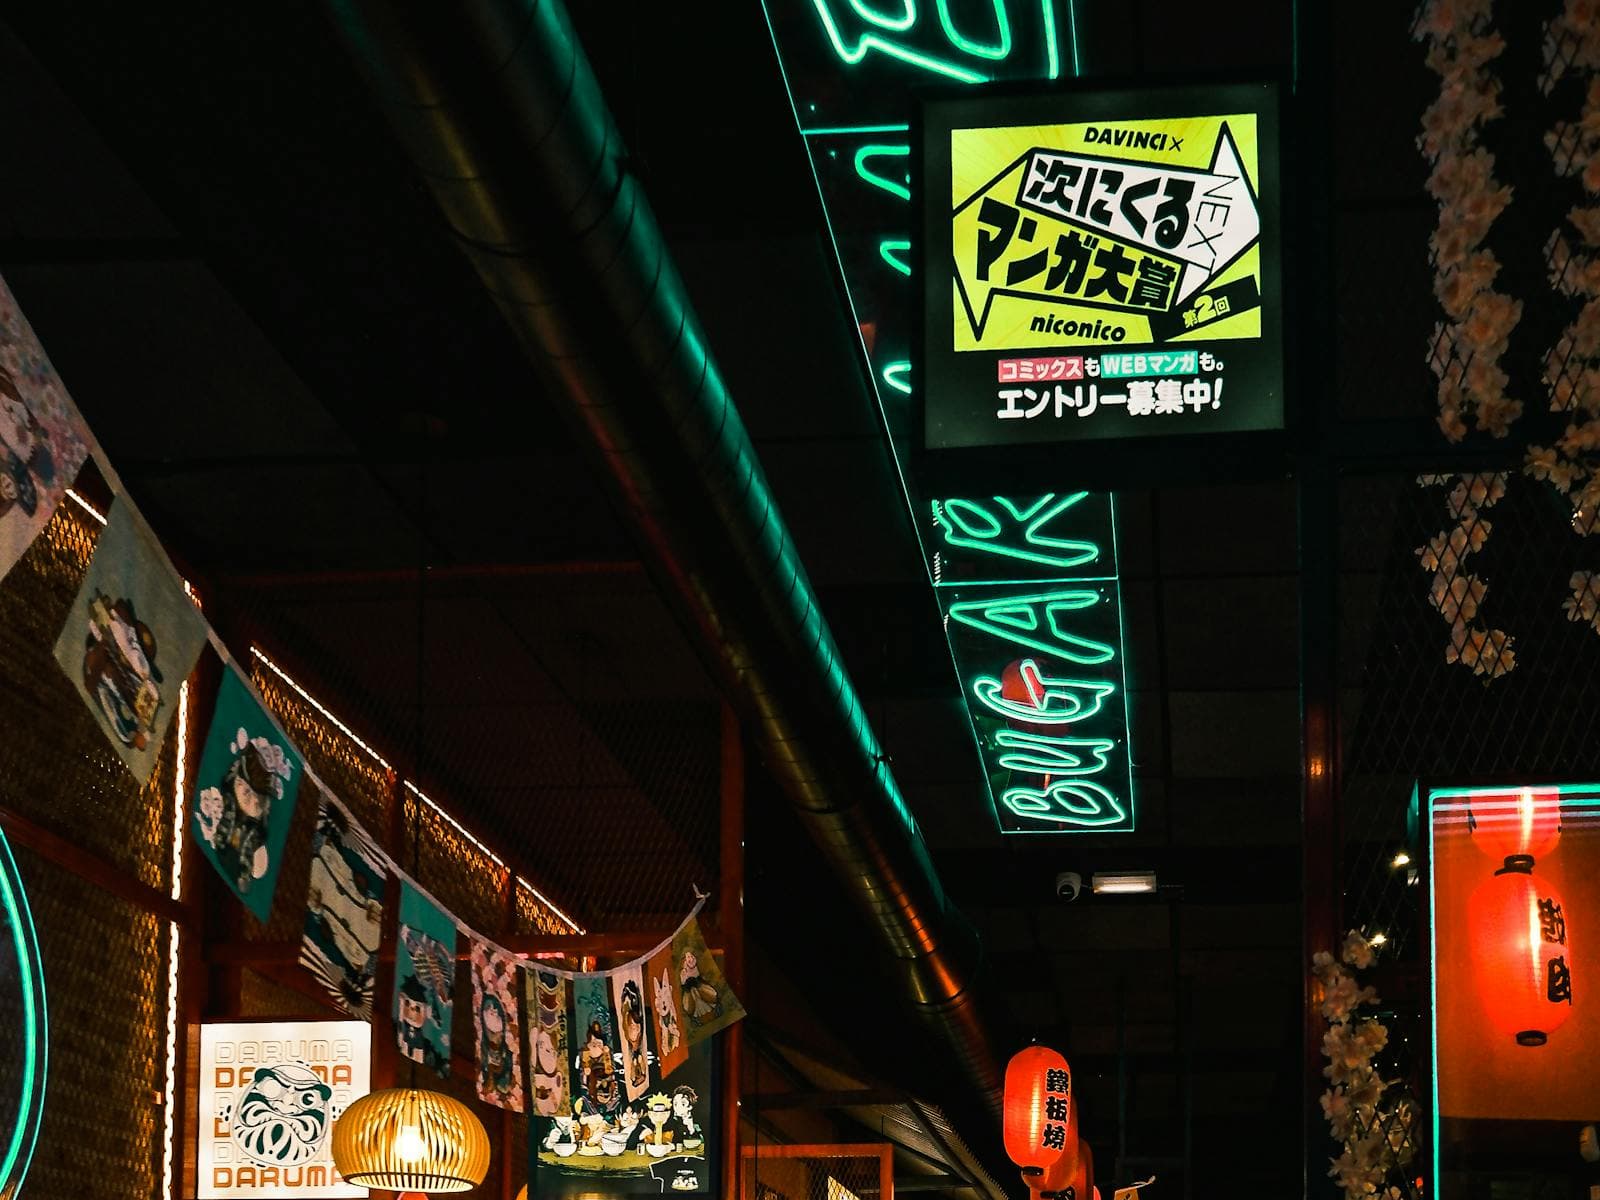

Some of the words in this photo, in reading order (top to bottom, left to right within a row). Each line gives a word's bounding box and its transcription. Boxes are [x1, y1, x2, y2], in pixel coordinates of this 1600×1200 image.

[1083, 126, 1167, 151] DAVINCI
[1026, 157, 1196, 250] 次にくる
[975, 196, 1177, 313] マンガ大賞
[1182, 294, 1231, 328] 第2回
[1029, 313, 1127, 342] niconico
[214, 1039, 353, 1064] DARUMA
